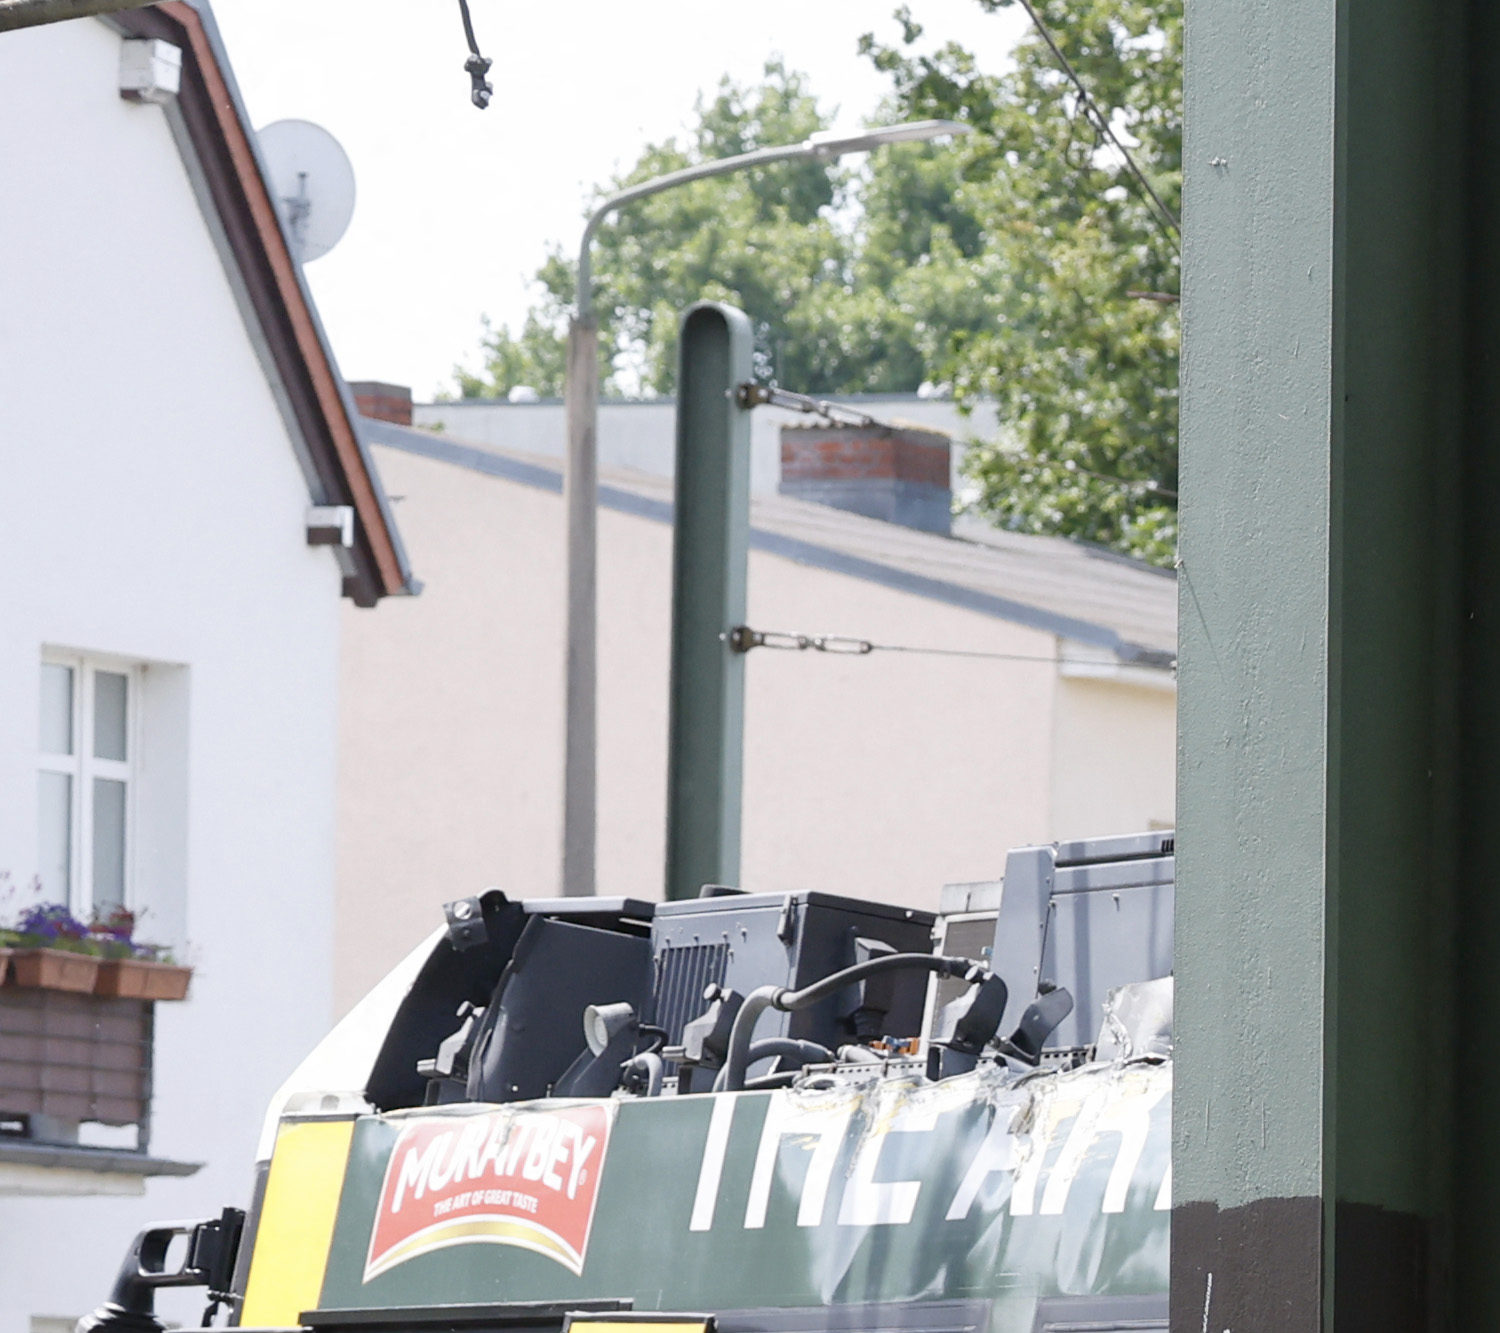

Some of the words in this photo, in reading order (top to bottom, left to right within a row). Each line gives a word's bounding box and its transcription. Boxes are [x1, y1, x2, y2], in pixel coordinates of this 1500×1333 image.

[391, 1115, 596, 1214] MURATBEY
[434, 1198, 453, 1217] THE
[453, 1193, 471, 1209] ART
[471, 1190, 484, 1206] OF
[484, 1188, 513, 1206] GREAT
[513, 1192, 538, 1213] TASTE
